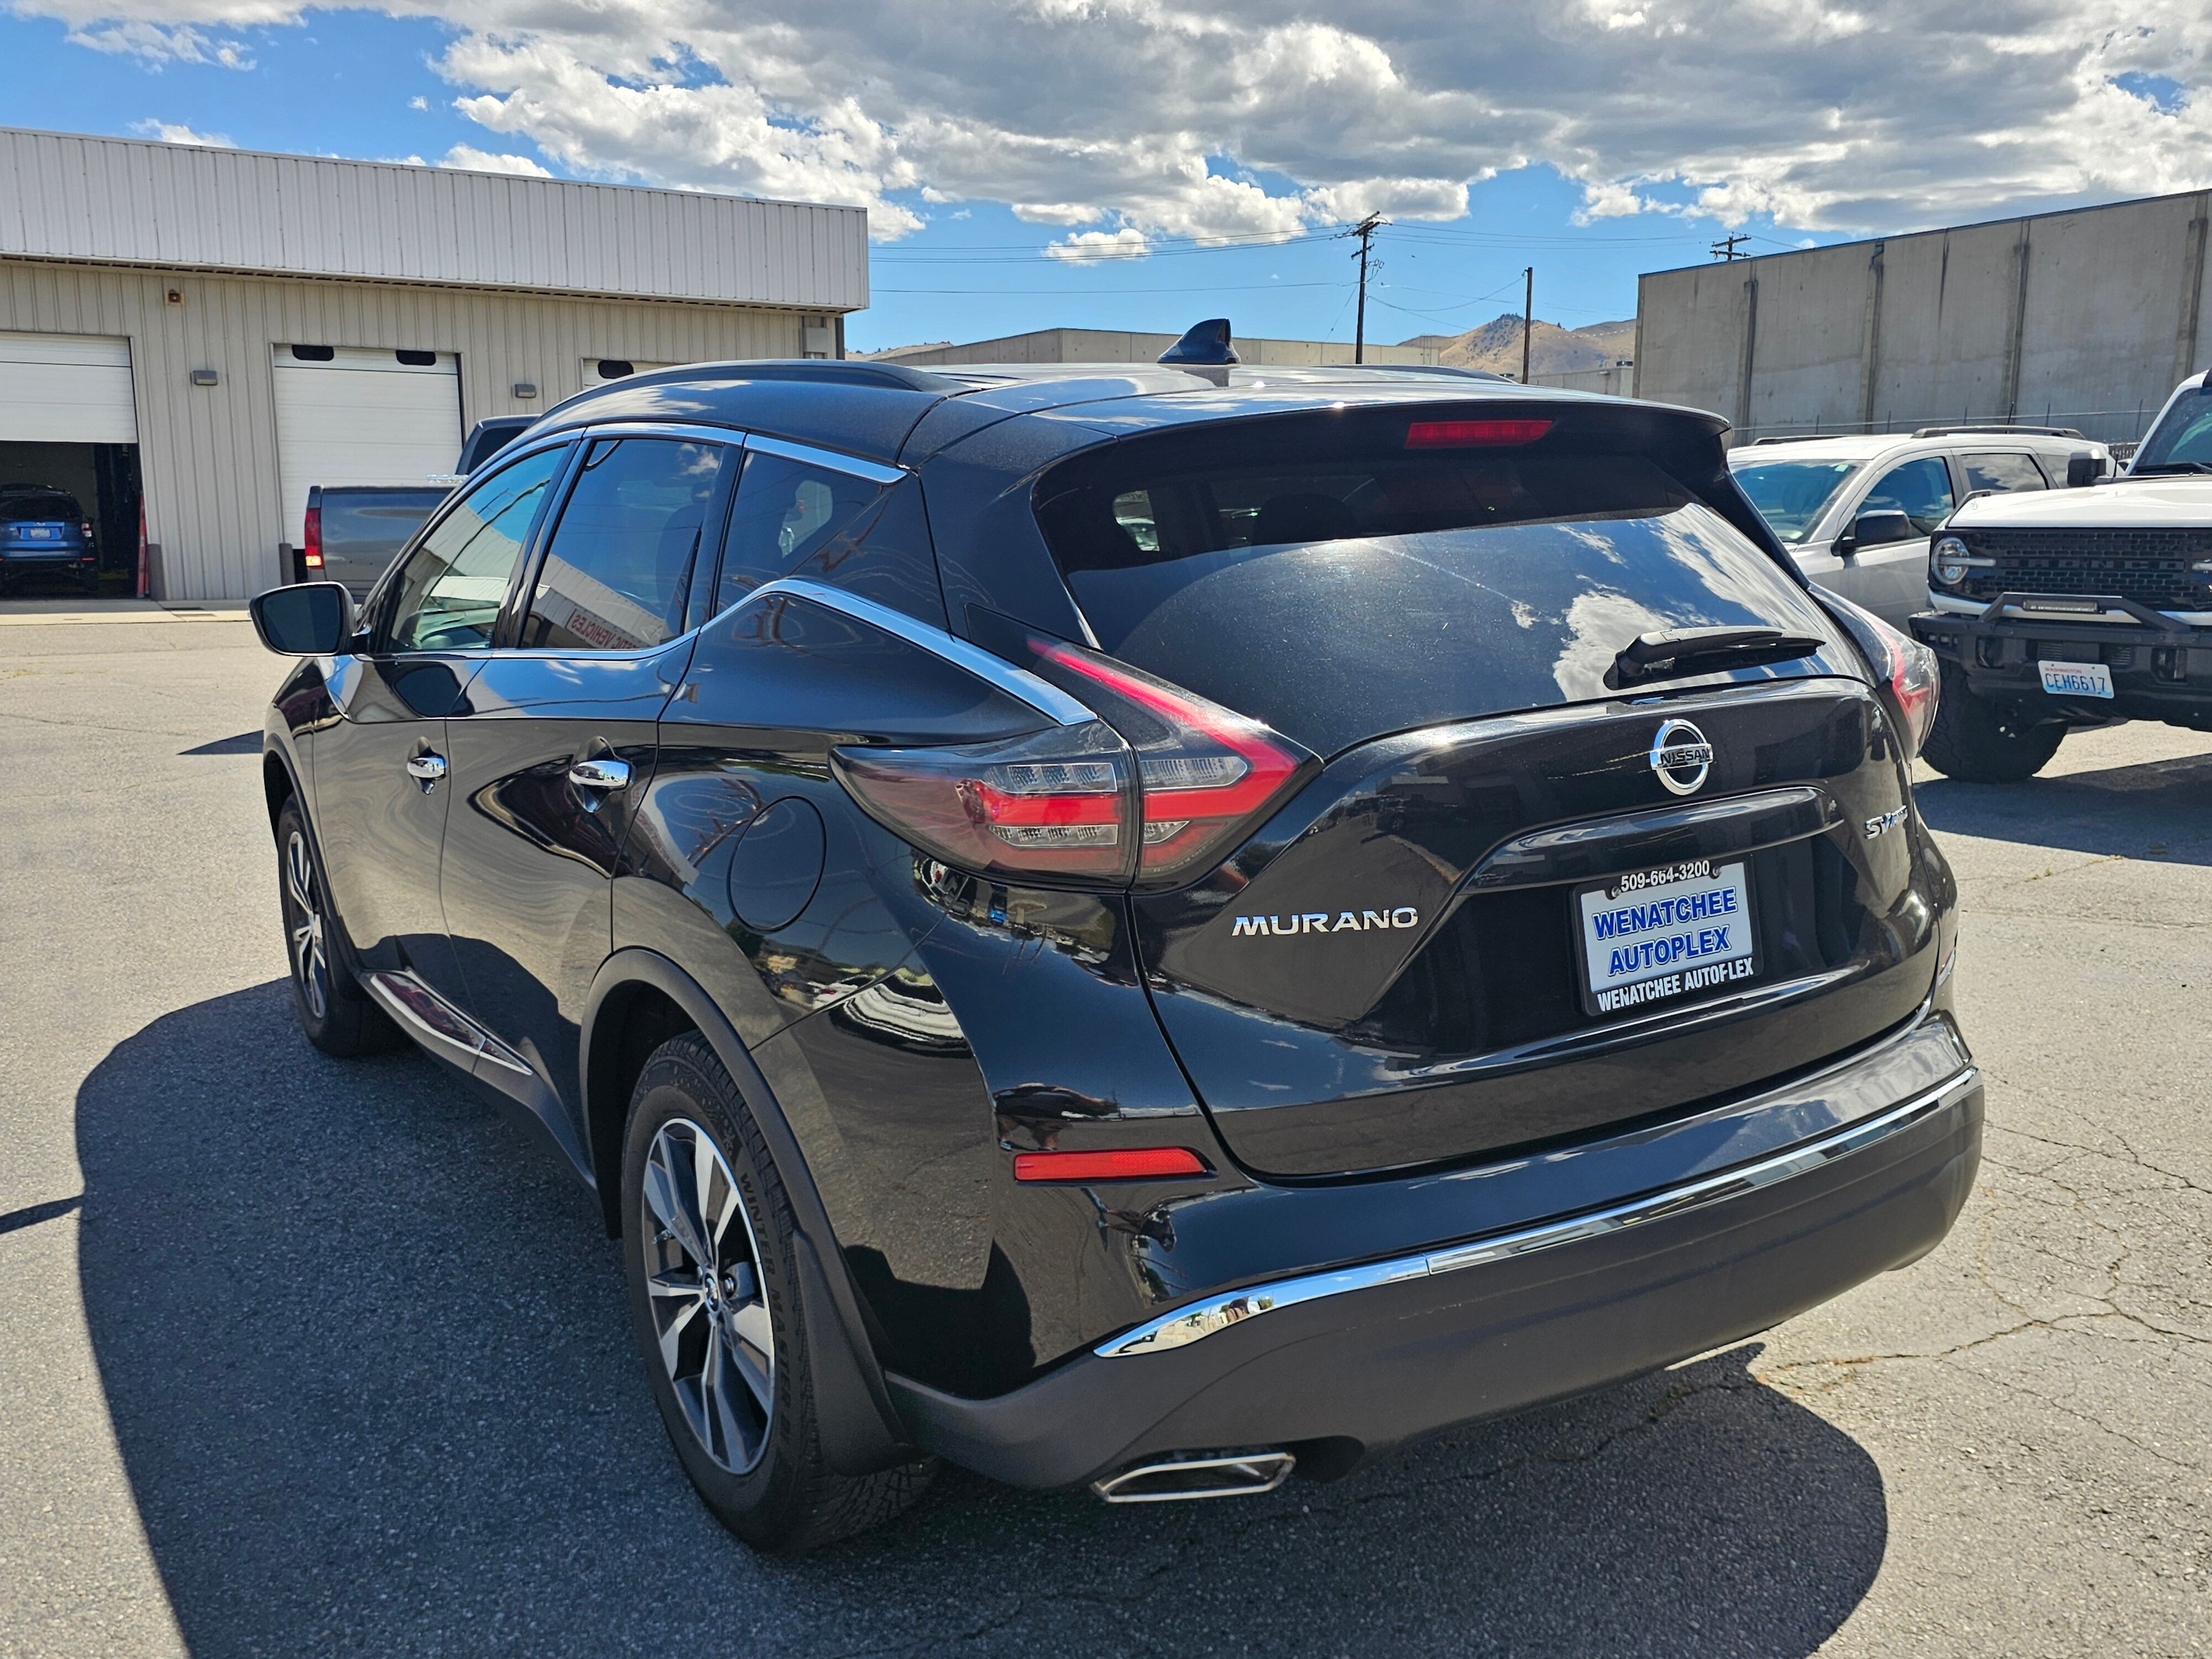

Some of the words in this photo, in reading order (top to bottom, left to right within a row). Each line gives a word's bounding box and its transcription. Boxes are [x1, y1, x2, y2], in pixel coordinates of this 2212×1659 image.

[2046, 673, 2105, 692] CEH6617
[1660, 748, 1710, 764] NISSAN
[1620, 860, 1710, 891] 509-664-3200
[1232, 906, 1418, 936] MURANO
[1593, 887, 1738, 940] WENATCHEE
[1608, 925, 1732, 977] AUTOPLEX
[1597, 974, 1681, 1012] WENATCHEE
[740, 1172, 776, 1275] WINTER
